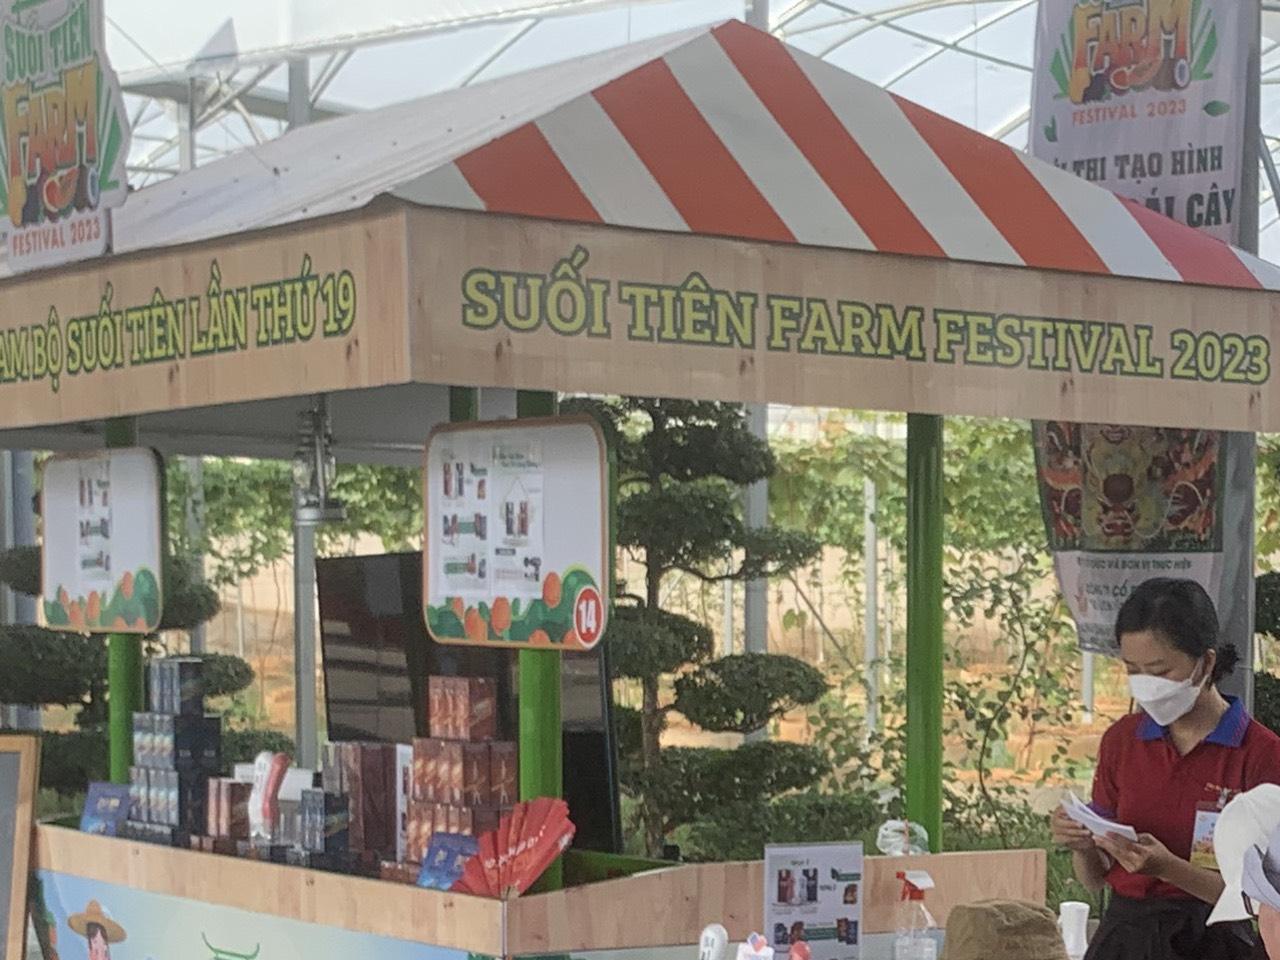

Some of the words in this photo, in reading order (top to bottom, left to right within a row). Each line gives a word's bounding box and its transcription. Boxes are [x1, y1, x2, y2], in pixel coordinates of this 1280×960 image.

[1071, 0, 1194, 72] FARM
[3, 58, 100, 184] FARM
[1071, 104, 1138, 126] FESTIVAL
[1147, 98, 1187, 118] 2023
[1114, 151, 1163, 185] TẠO
[1171, 142, 1223, 176] HÌNH
[1186, 181, 1236, 229] CÂY
[12, 230, 66, 257] FESTIVAL
[71, 216, 101, 246] 2023
[32, 305, 64, 393] BỘ
[66, 281, 124, 374] SUỐI
[125, 287, 186, 365] TIÊN
[189, 258, 248, 354] LẦN
[252, 253, 320, 347] THỨ
[321, 269, 356, 337] 19
[462, 247, 611, 337] SUỐI
[621, 272, 757, 351] TIÊN
[768, 295, 925, 364] FARM
[934, 307, 1162, 378] FESTIVAL
[1171, 330, 1272, 385] 2023
[579, 599, 596, 634] 14
